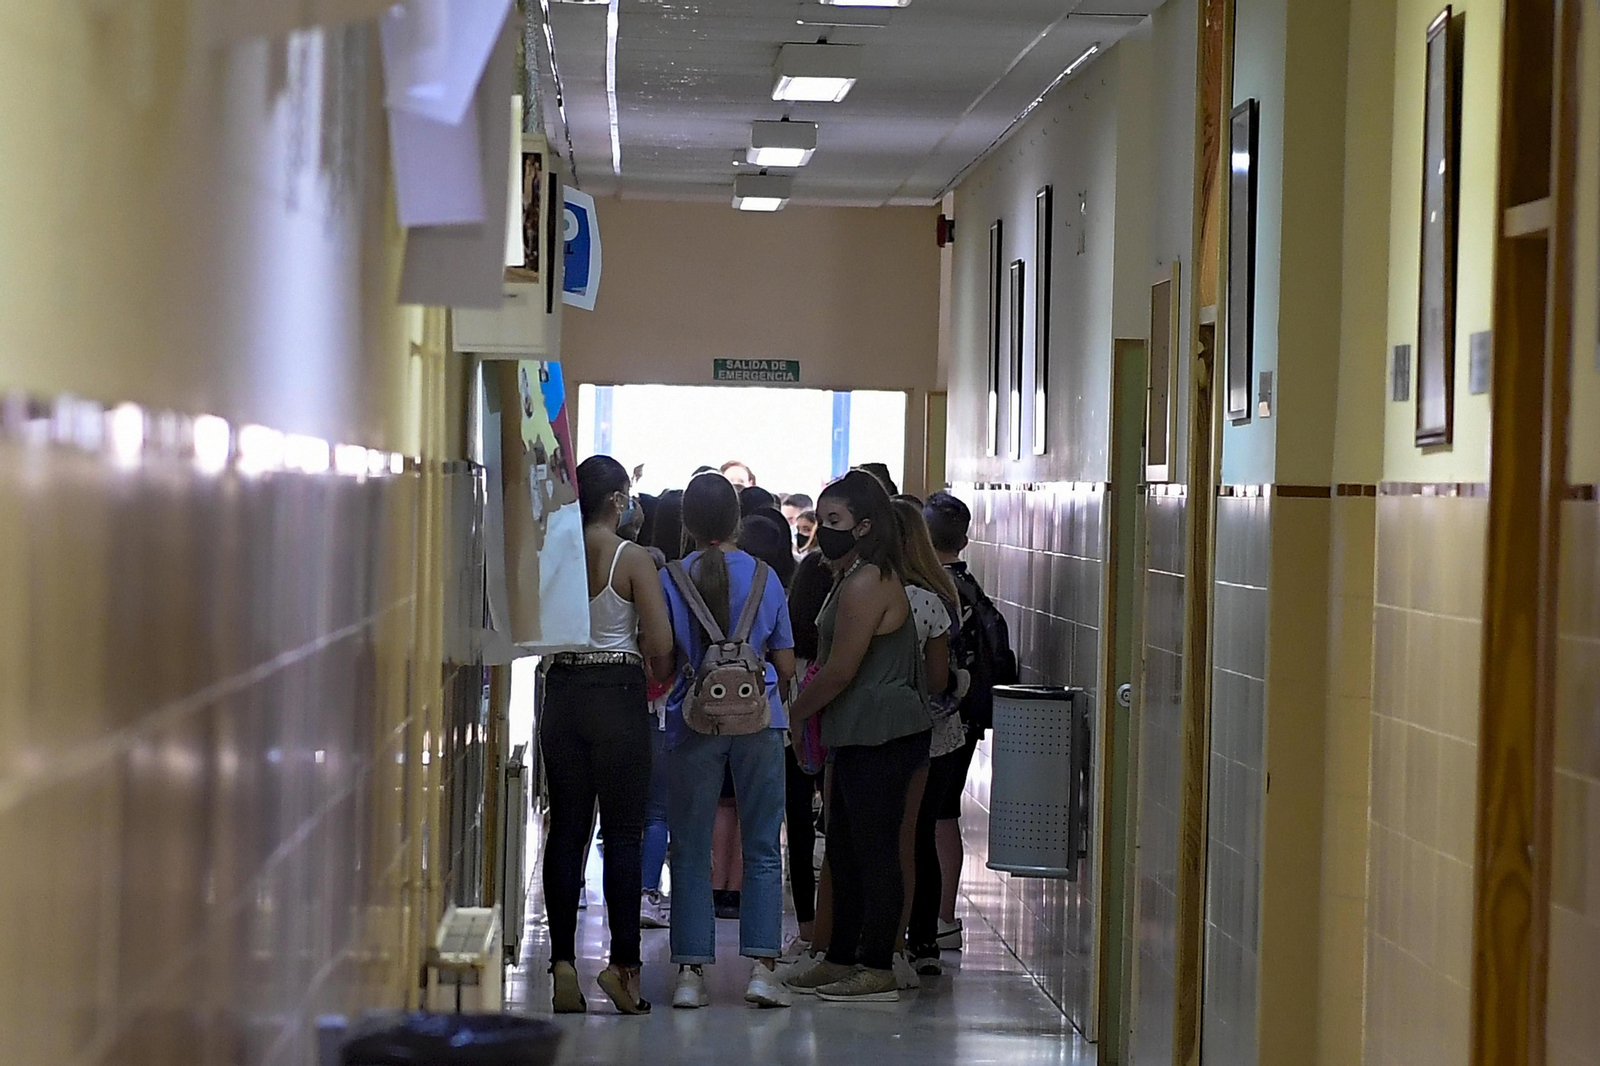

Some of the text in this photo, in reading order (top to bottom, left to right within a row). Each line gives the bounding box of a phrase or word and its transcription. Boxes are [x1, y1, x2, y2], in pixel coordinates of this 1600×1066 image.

[726, 360, 787, 370] SALIDA DE
[718, 370, 794, 381] EMERGENCIA
